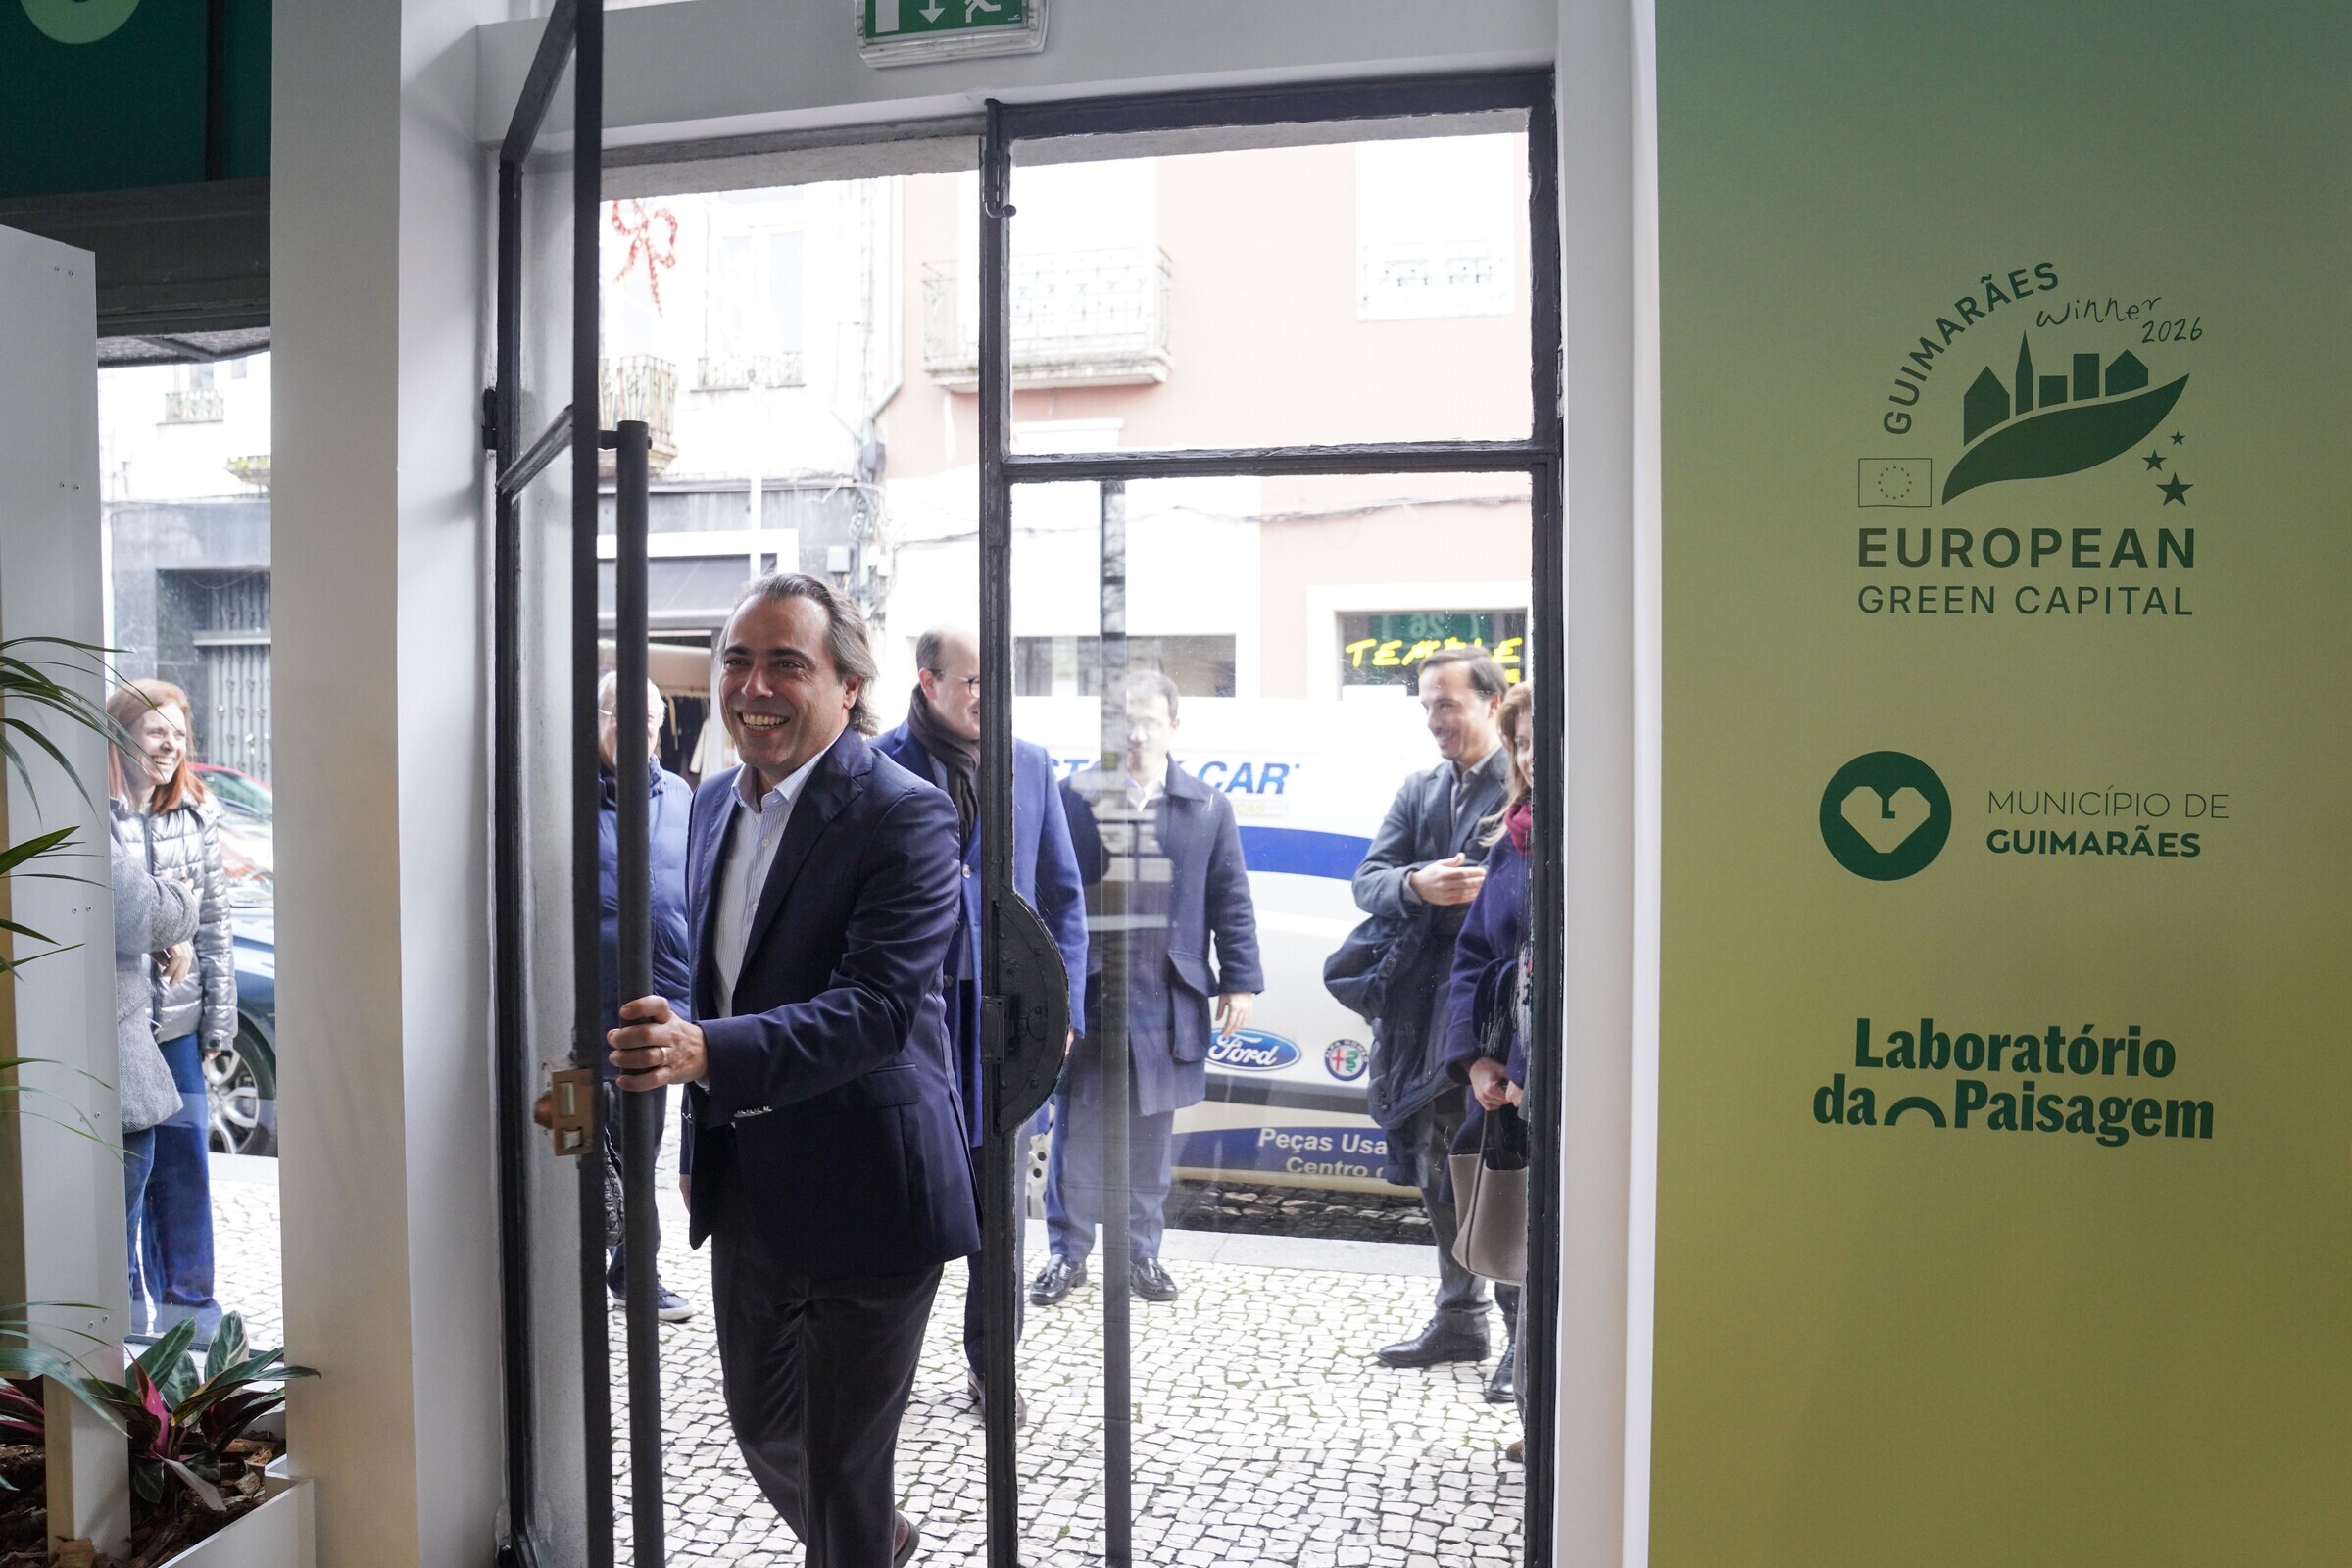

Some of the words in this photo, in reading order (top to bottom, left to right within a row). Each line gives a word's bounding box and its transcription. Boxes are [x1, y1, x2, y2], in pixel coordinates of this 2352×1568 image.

[2141, 317, 2203, 345] 2026
[1883, 262, 2059, 435] GUIMARÃES
[1858, 527, 2195, 569] EUROPEAN
[1857, 585, 1995, 614] GREEN
[2015, 585, 2193, 616] CAPITAL
[1345, 637, 1524, 667] TEME
[1197, 760, 1291, 795] CAR
[1987, 785, 2171, 818] MUNICÍPIO
[2184, 793, 2230, 819] DE
[1985, 824, 2201, 858] GUIMARÃES
[1208, 1032, 1280, 1066] Ford
[1854, 1017, 2177, 1079] Laboratório
[1812, 1072, 1878, 1127] da
[1953, 1078, 2215, 1148] Paisagem
[1257, 1127, 1334, 1153] Peças
[1341, 1133, 1388, 1155] Usa
[1285, 1156, 1369, 1177] Centro
